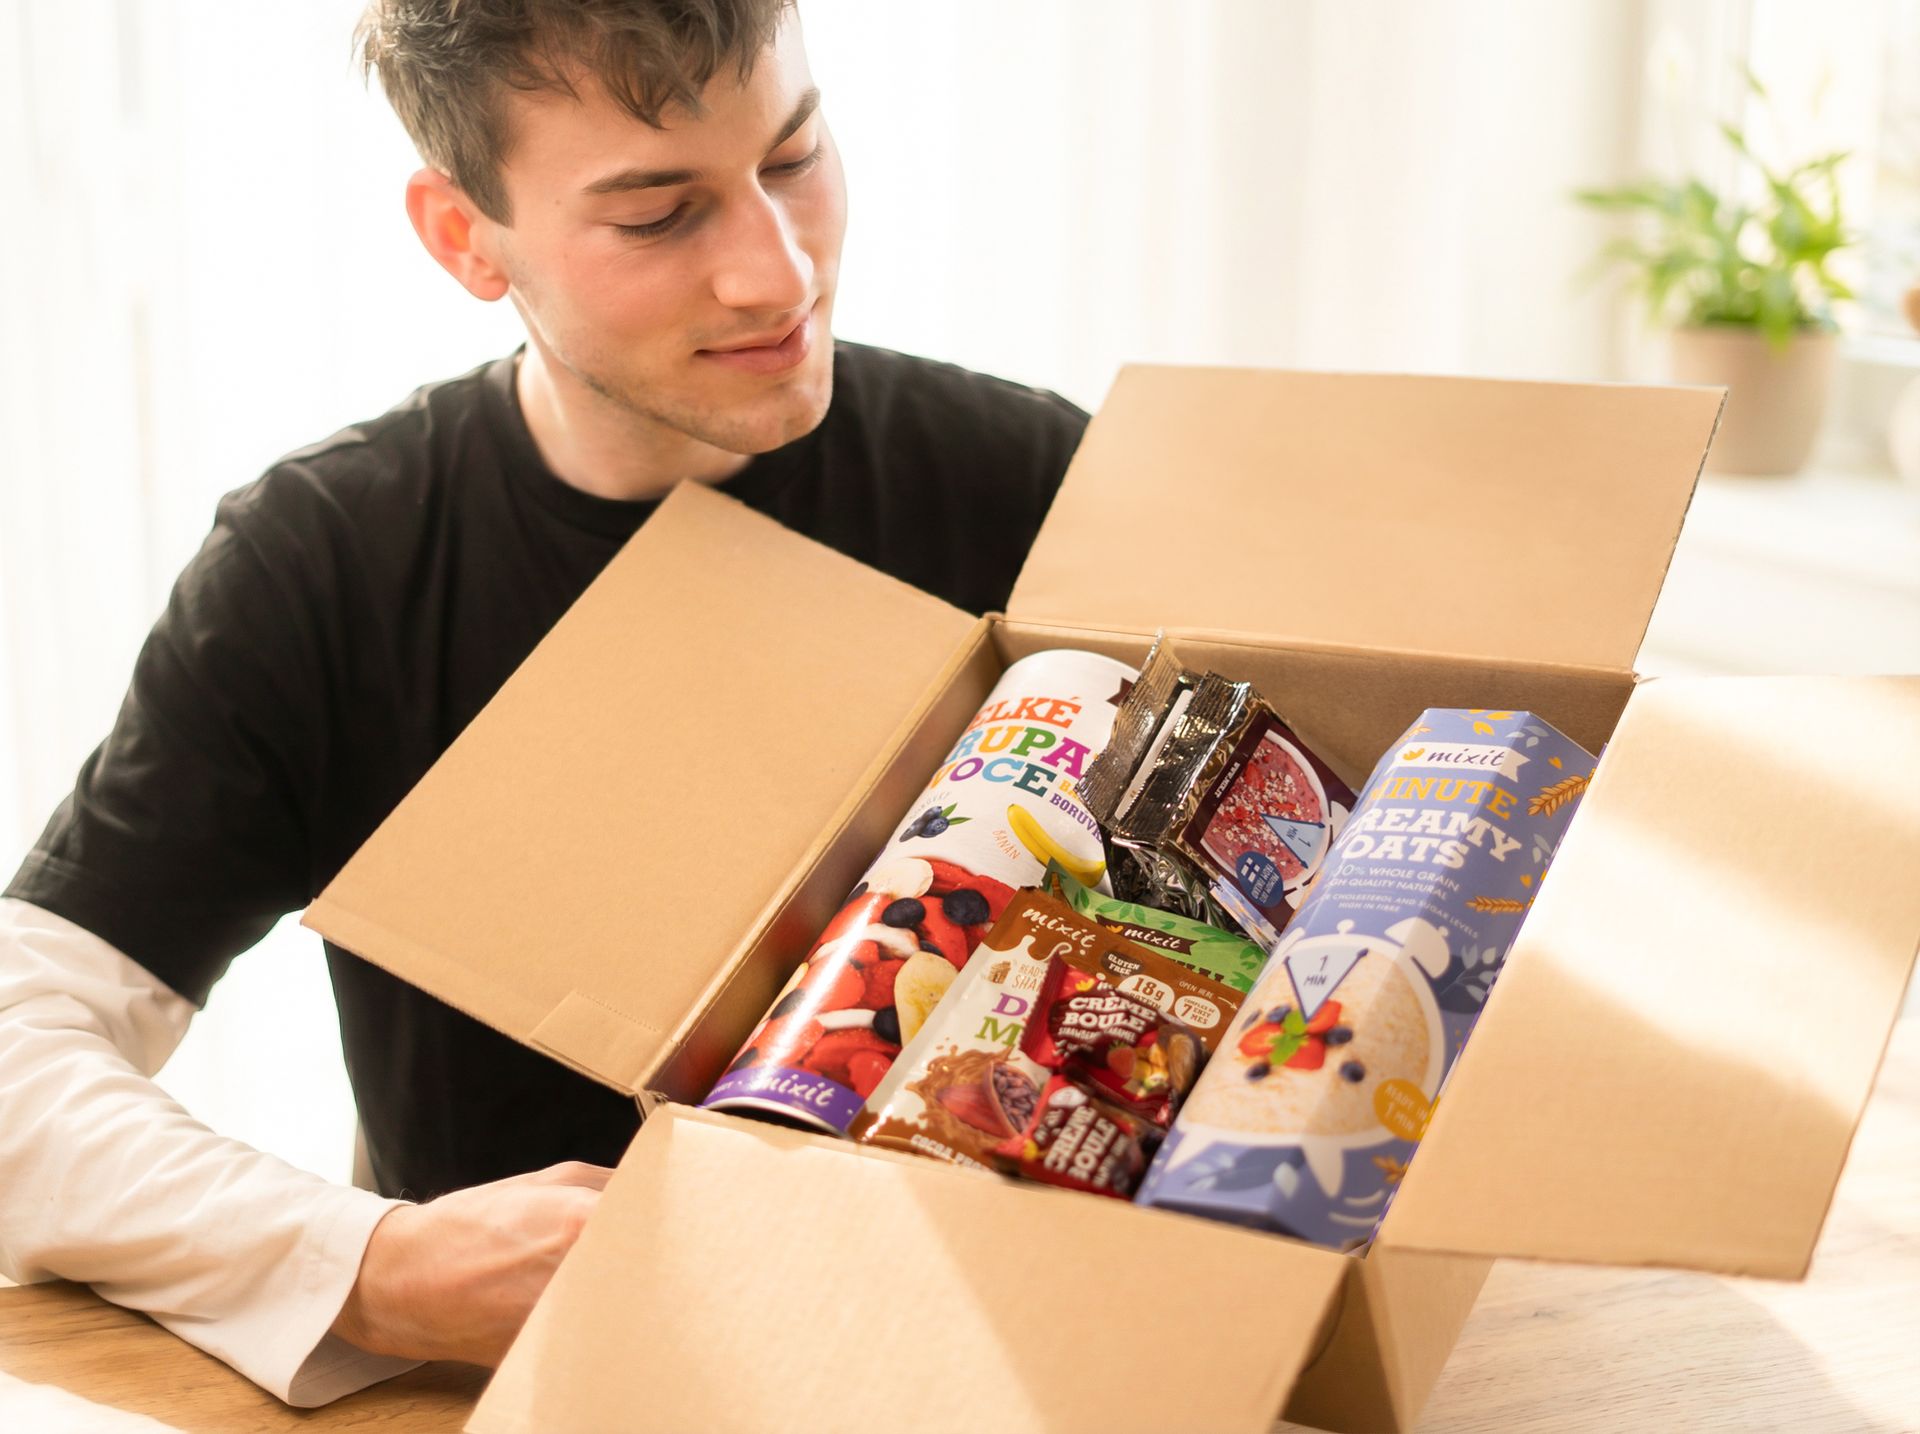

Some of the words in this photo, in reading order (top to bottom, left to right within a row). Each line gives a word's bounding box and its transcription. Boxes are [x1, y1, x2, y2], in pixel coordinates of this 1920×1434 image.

[966, 696, 1082, 732] ELKÉ
[944, 725, 1098, 780] RUPA
[1428, 748, 1506, 766] mixit
[927, 757, 1058, 798] VOCE
[1341, 834, 1470, 869] OATS
[1348, 878, 1395, 888] QUALITY
[1394, 880, 1449, 901] NATURAL
[1369, 866, 1415, 878] WHOLE
[1416, 869, 1460, 892] GRAIN
[1332, 892, 1394, 903] CHOLESTEROL
[1394, 896, 1417, 906] AND
[1418, 898, 1453, 920] SUGAR
[1449, 916, 1480, 940] LEVELS
[1338, 901, 1361, 910] HIGH
[1363, 902, 1375, 910] IN
[1375, 904, 1400, 913] FIBRE
[1021, 907, 1097, 949] mixit
[1123, 927, 1182, 949] mixit
[1107, 953, 1141, 971] GLUTEN
[1108, 963, 1132, 976] FREE
[1319, 955, 1329, 972] 1
[1179, 980, 1198, 992] OPEN
[1199, 988, 1215, 999] HERE
[1303, 974, 1328, 986] MIN
[991, 992, 1029, 1018] D
[1069, 991, 1157, 1021] CRÈME
[1181, 1002, 1193, 1017] 7
[975, 1016, 1024, 1048] M
[1062, 1012, 1147, 1032] BOULE
[1386, 1101, 1395, 1118] 1
[910, 1133, 954, 1161] COCOA
